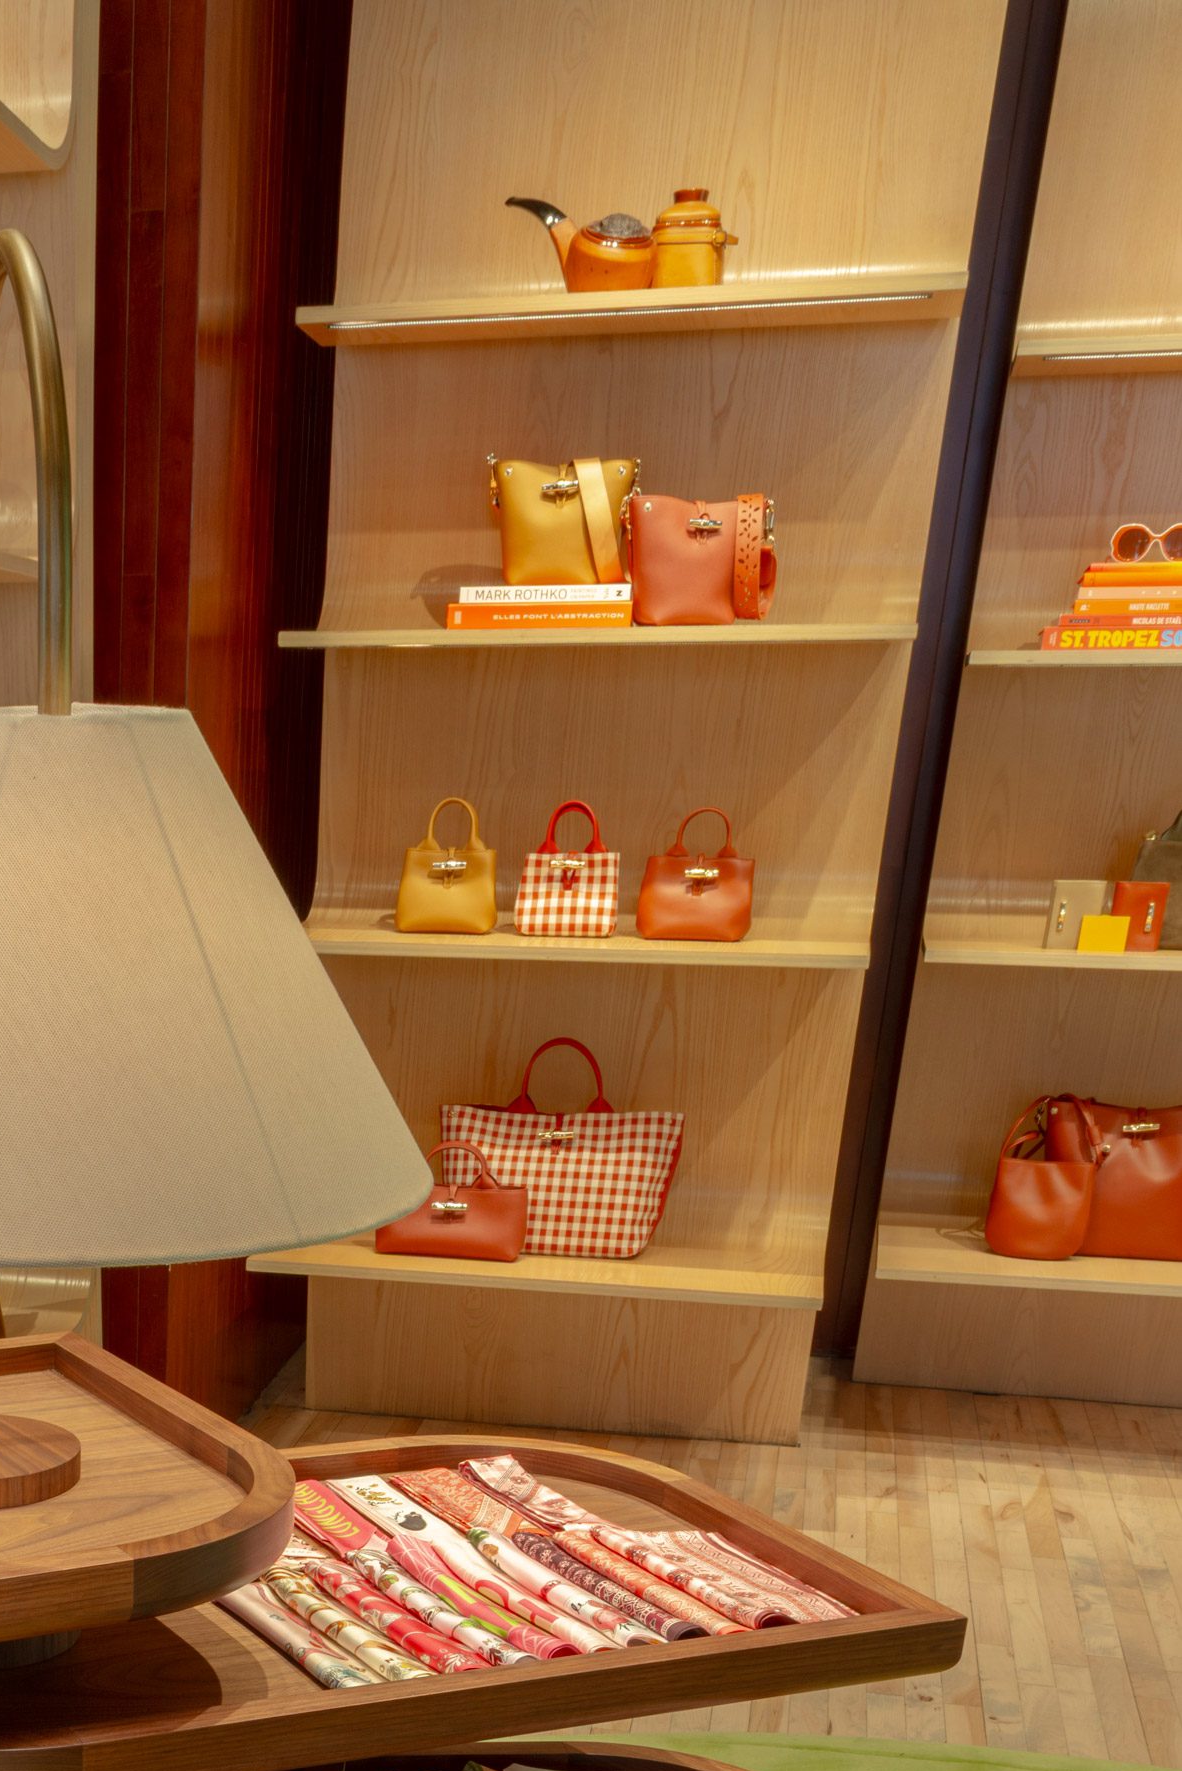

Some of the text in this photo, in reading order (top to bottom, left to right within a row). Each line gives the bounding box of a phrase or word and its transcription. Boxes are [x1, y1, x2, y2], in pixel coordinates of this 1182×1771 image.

[474, 588, 511, 601] MARK
[514, 588, 568, 600] ROTHKO
[492, 613, 521, 621] ELLES
[550, 611, 625, 620] L'ABSTRACTION
[1059, 629, 1086, 648] ST.
[1086, 629, 1160, 648] TROPEZ
